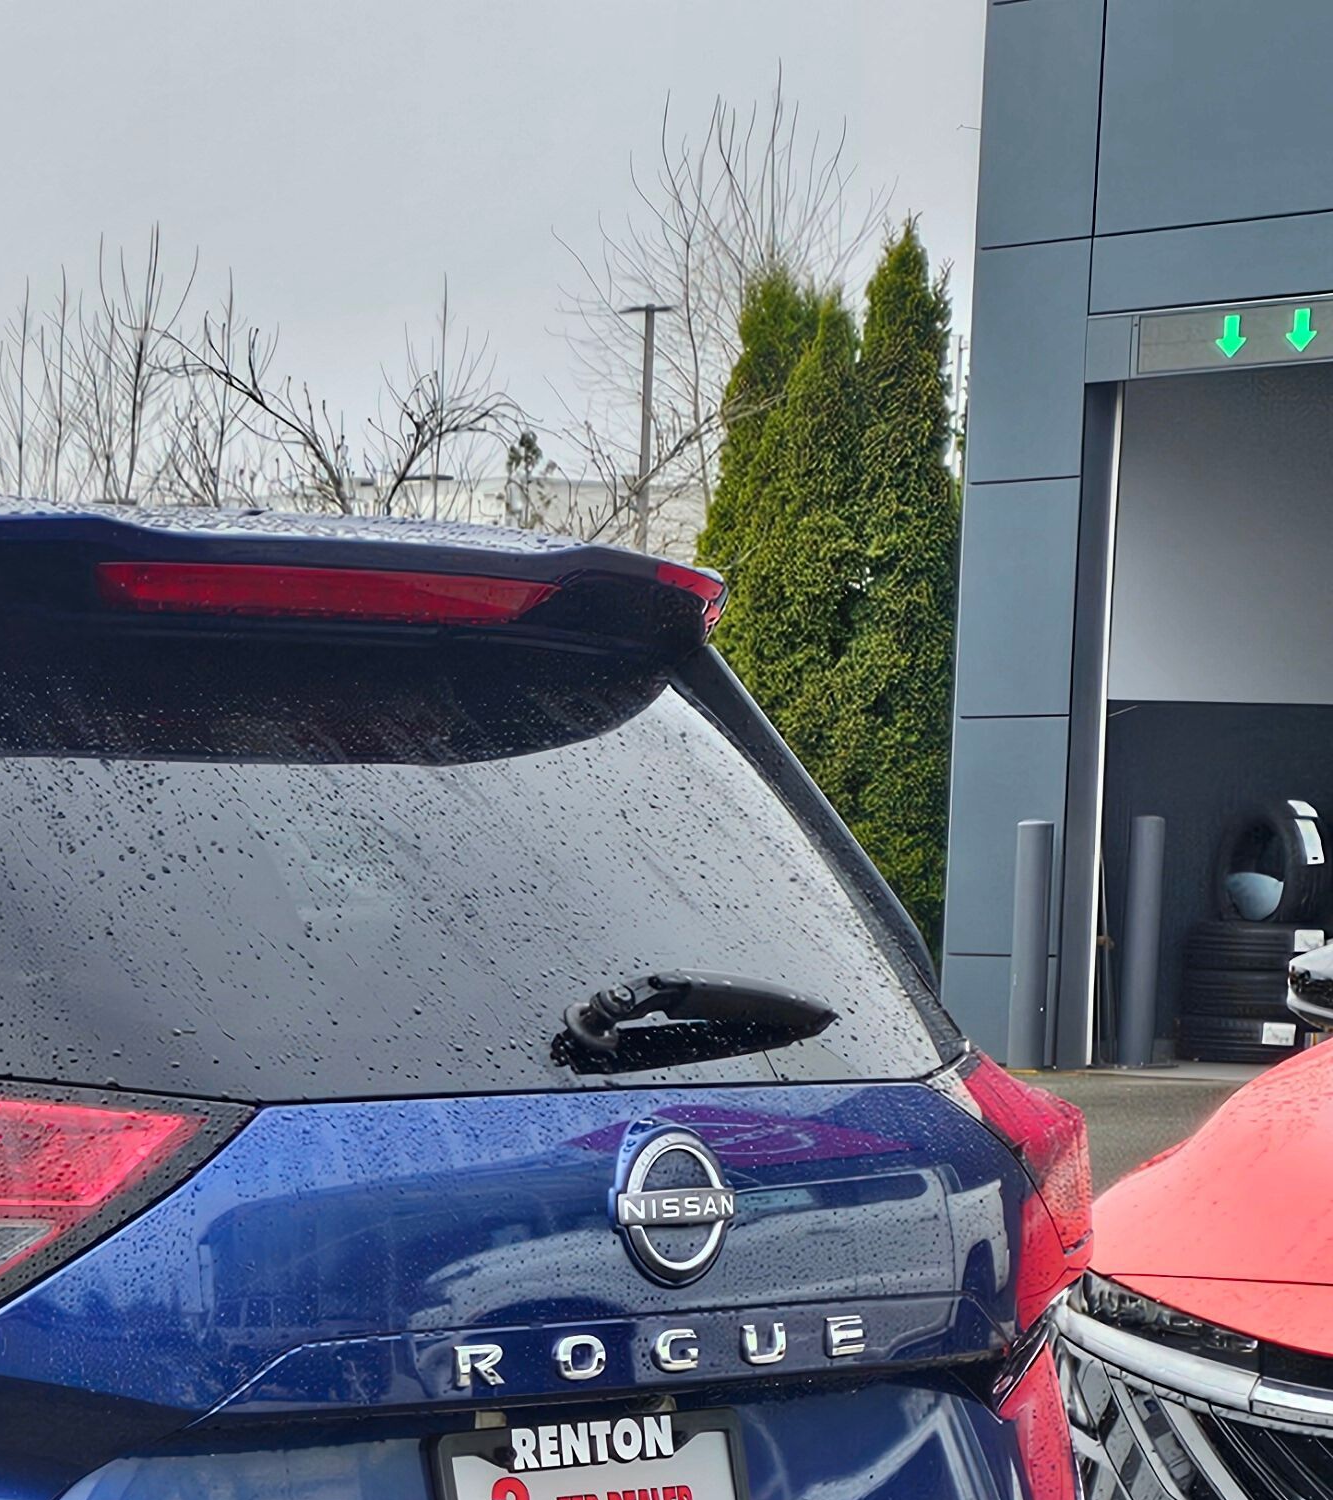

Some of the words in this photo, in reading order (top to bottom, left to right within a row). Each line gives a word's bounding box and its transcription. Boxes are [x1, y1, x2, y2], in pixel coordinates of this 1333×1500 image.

[623, 1194, 734, 1222] NISSAN
[454, 1314, 866, 1388] ROGUE
[511, 1414, 675, 1471] RENTON
